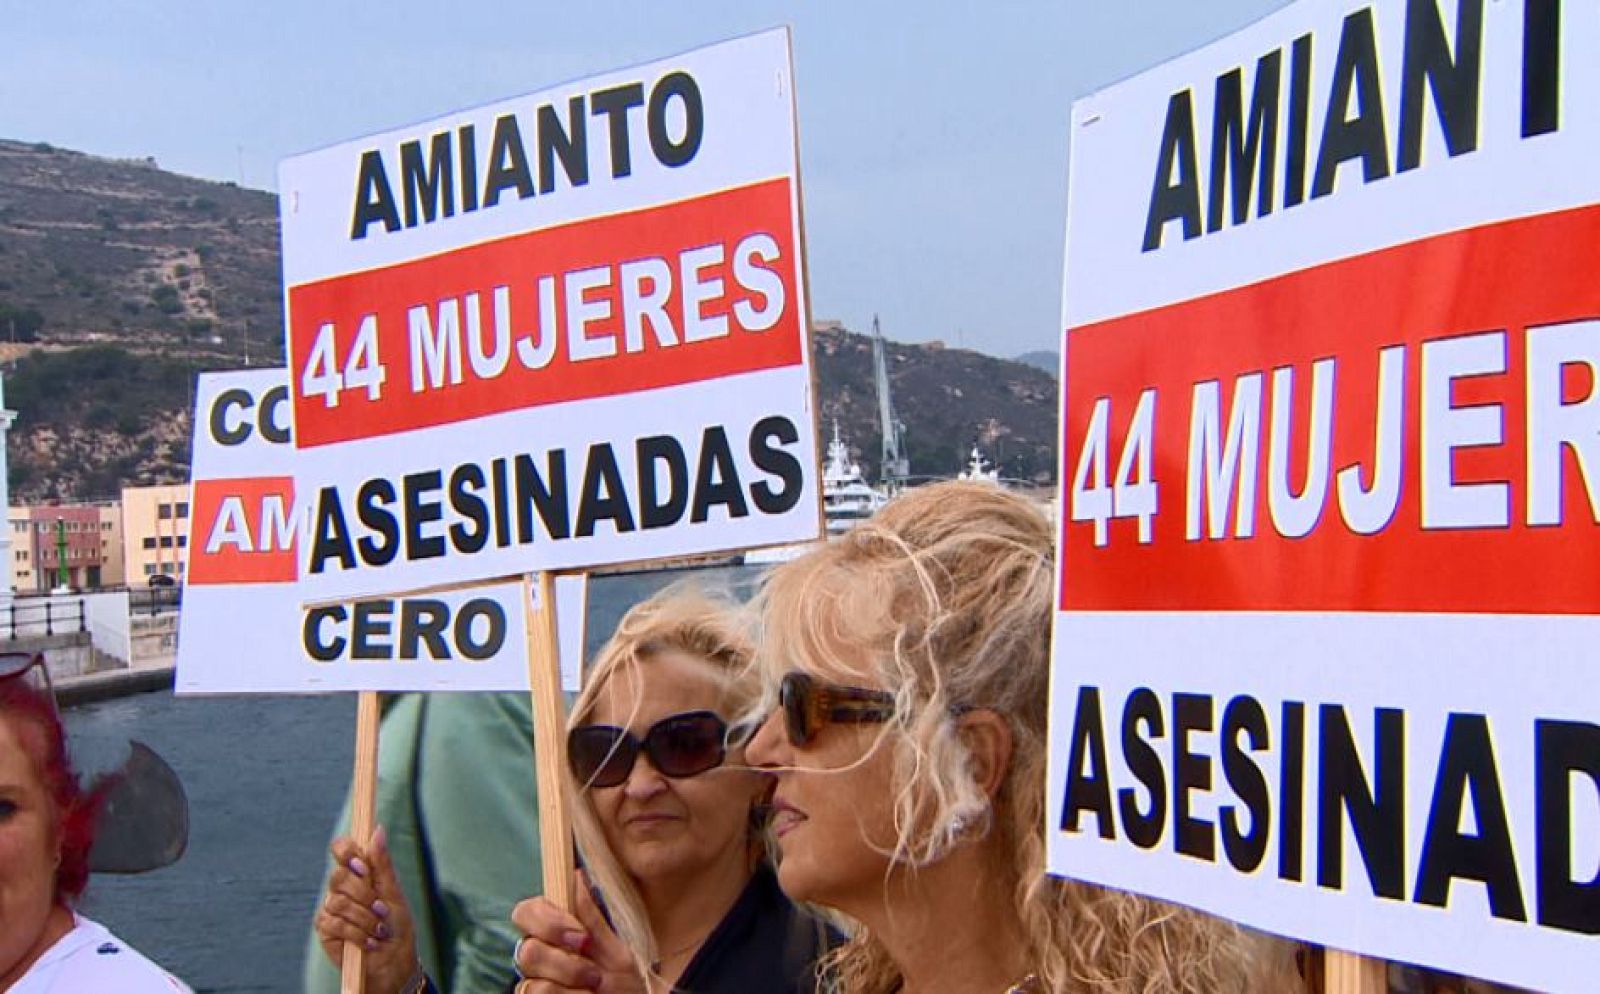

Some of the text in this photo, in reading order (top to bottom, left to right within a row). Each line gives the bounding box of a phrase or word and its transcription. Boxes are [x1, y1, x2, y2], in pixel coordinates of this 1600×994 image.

[350, 71, 704, 240] AMIANTO
[301, 232, 786, 408] 44 MUJERES
[308, 415, 804, 574] ASESINADAS
[1071, 317, 1600, 547] 44 MUJER
[205, 495, 298, 553] AM
[303, 597, 507, 662] CERO
[1060, 685, 1600, 935] ASESINAD
